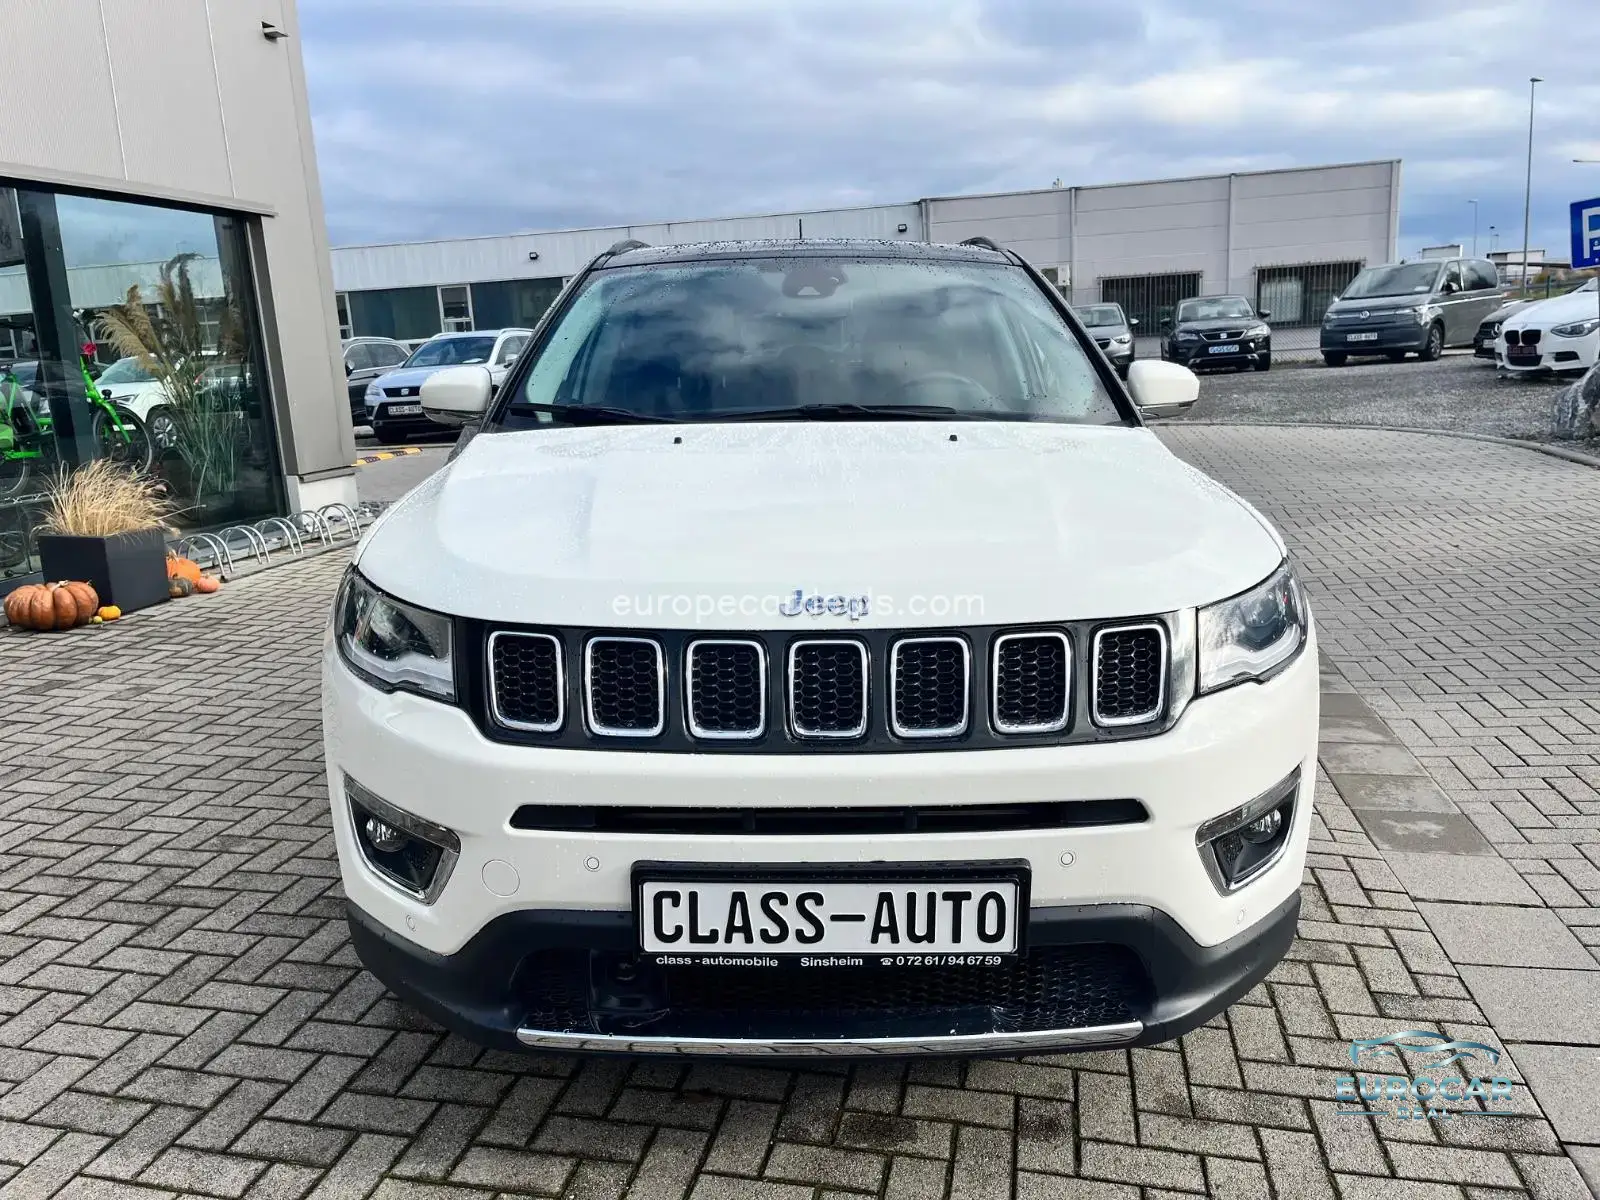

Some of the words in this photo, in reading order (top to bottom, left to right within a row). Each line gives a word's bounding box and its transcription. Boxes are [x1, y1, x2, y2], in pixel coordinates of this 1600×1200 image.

[779, 589, 869, 621] Jeep
[652, 890, 1007, 945] CLASS-AUTO
[800, 956, 863, 967] Sinsheim
